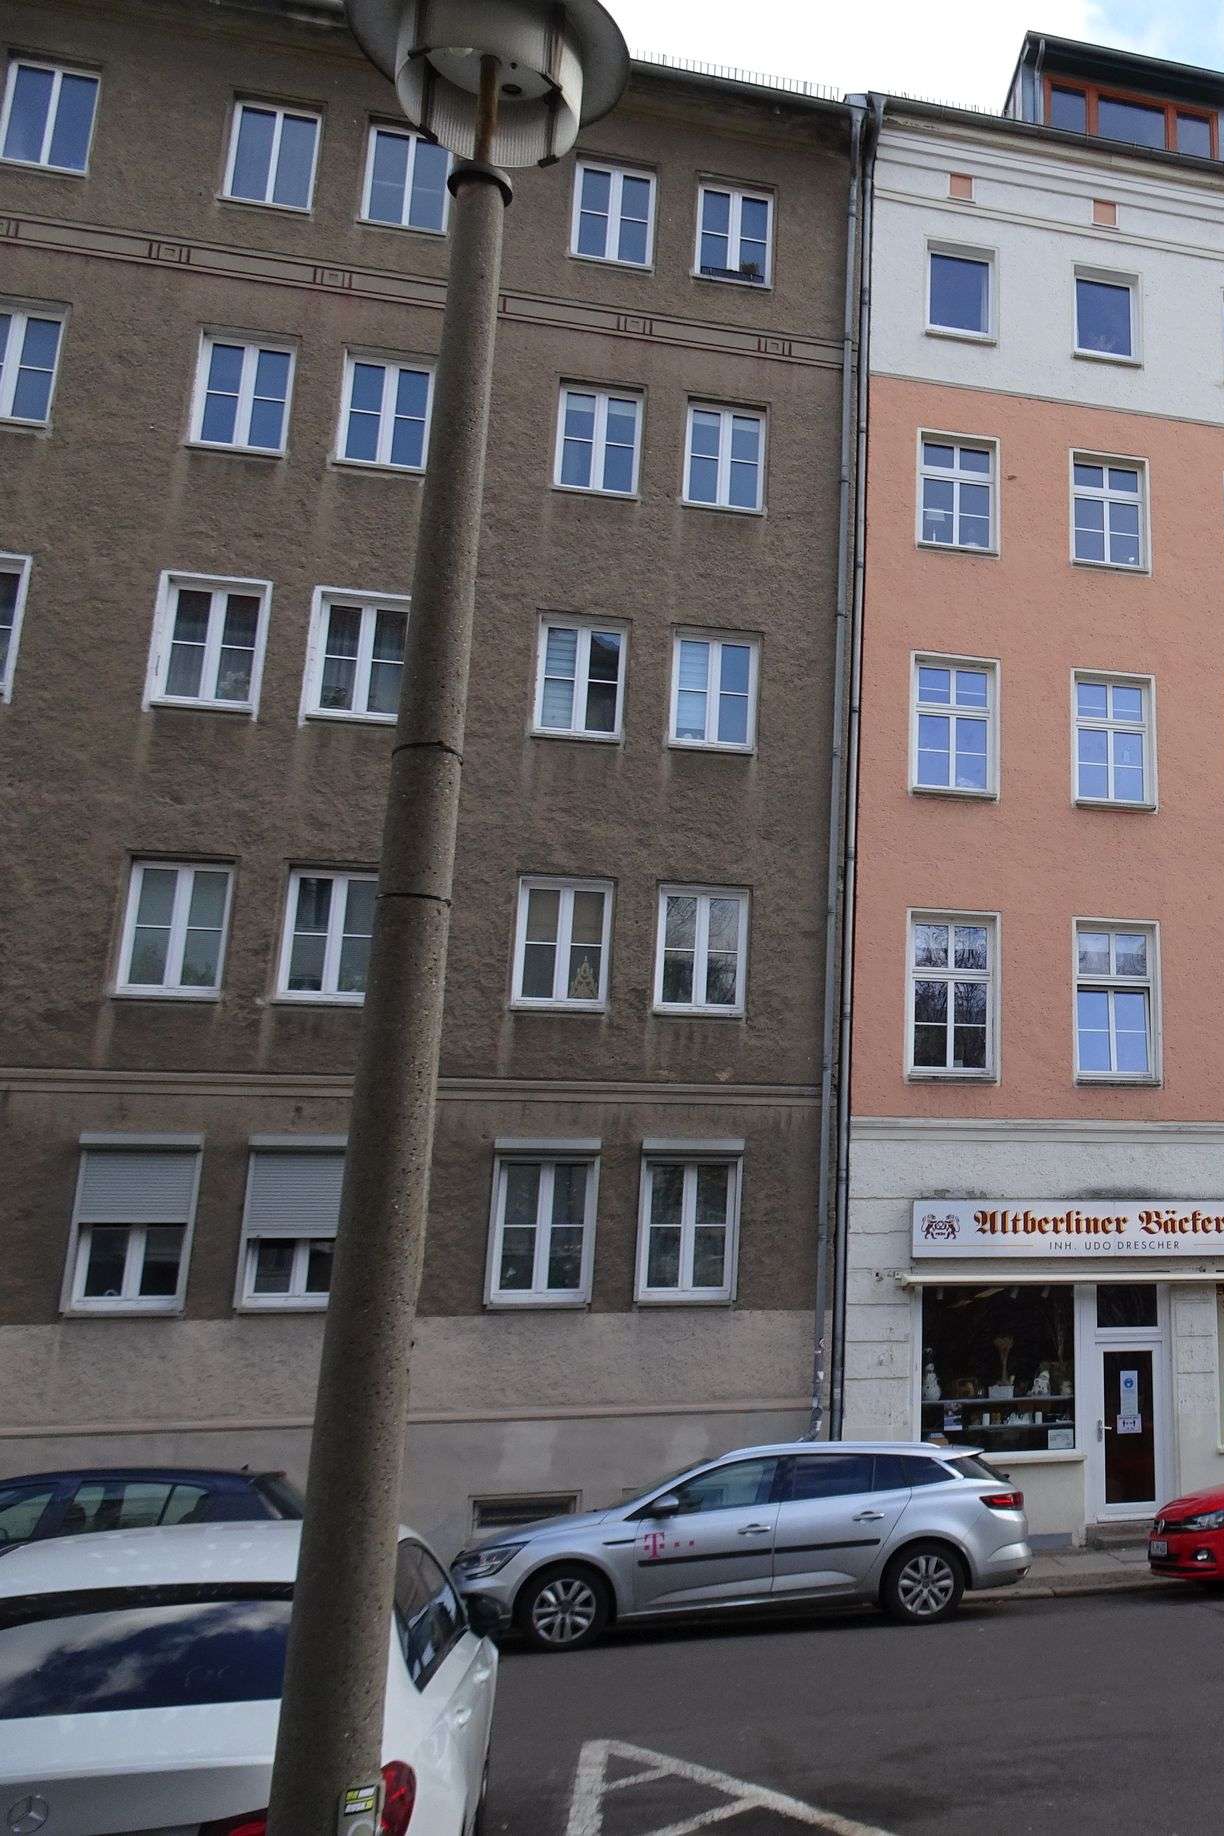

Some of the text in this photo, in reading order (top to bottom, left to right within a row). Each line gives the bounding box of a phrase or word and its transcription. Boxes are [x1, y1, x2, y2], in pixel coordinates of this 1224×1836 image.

[973, 1209, 1129, 1236] Altberliner
[1049, 1240, 1180, 1251] INH. UDO DRESCHER
